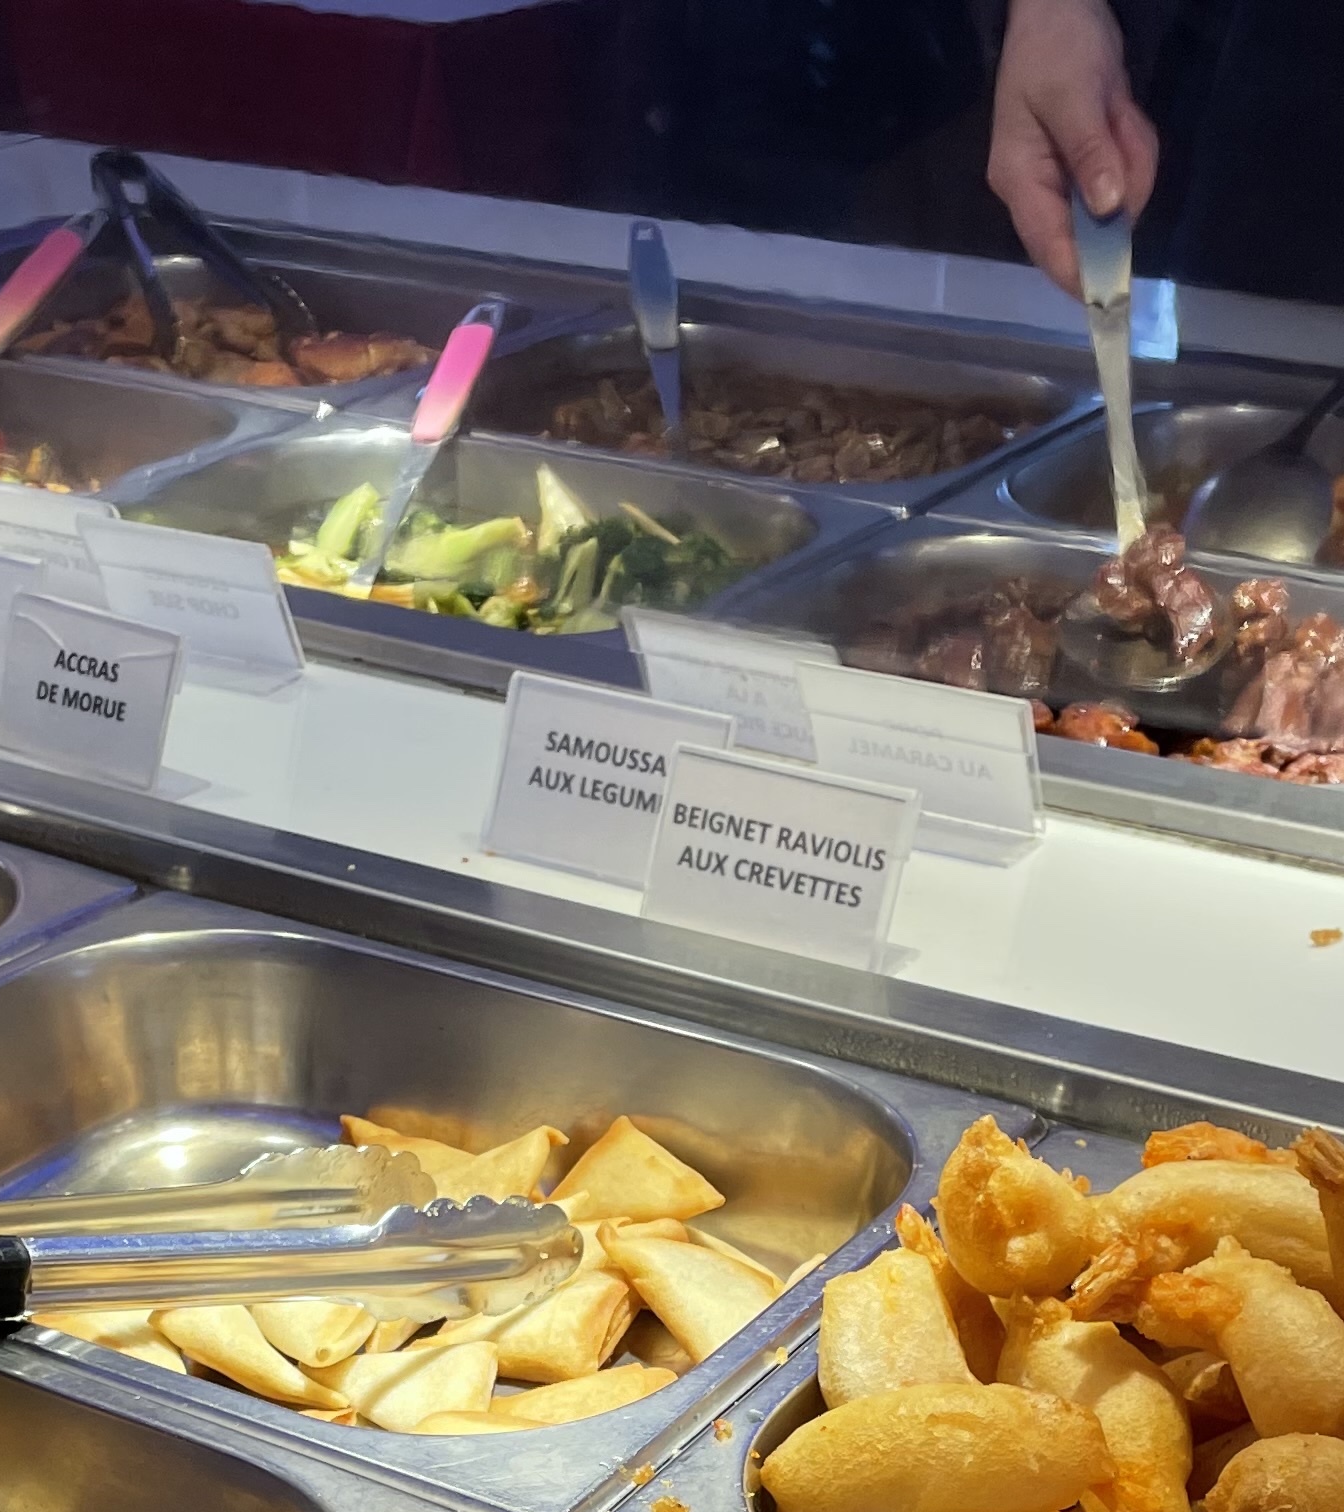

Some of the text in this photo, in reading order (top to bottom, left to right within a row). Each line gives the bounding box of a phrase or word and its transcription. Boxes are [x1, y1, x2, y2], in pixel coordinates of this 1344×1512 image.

[54, 649, 120, 683] ACCRAS
[36, 680, 127, 722] DE MORUE
[544, 730, 666, 777] SAMOUSSA
[527, 765, 573, 796] AUX
[673, 803, 887, 872] BEIGNET RAVIOLIS
[677, 845, 863, 909] AUX CREVETTES
